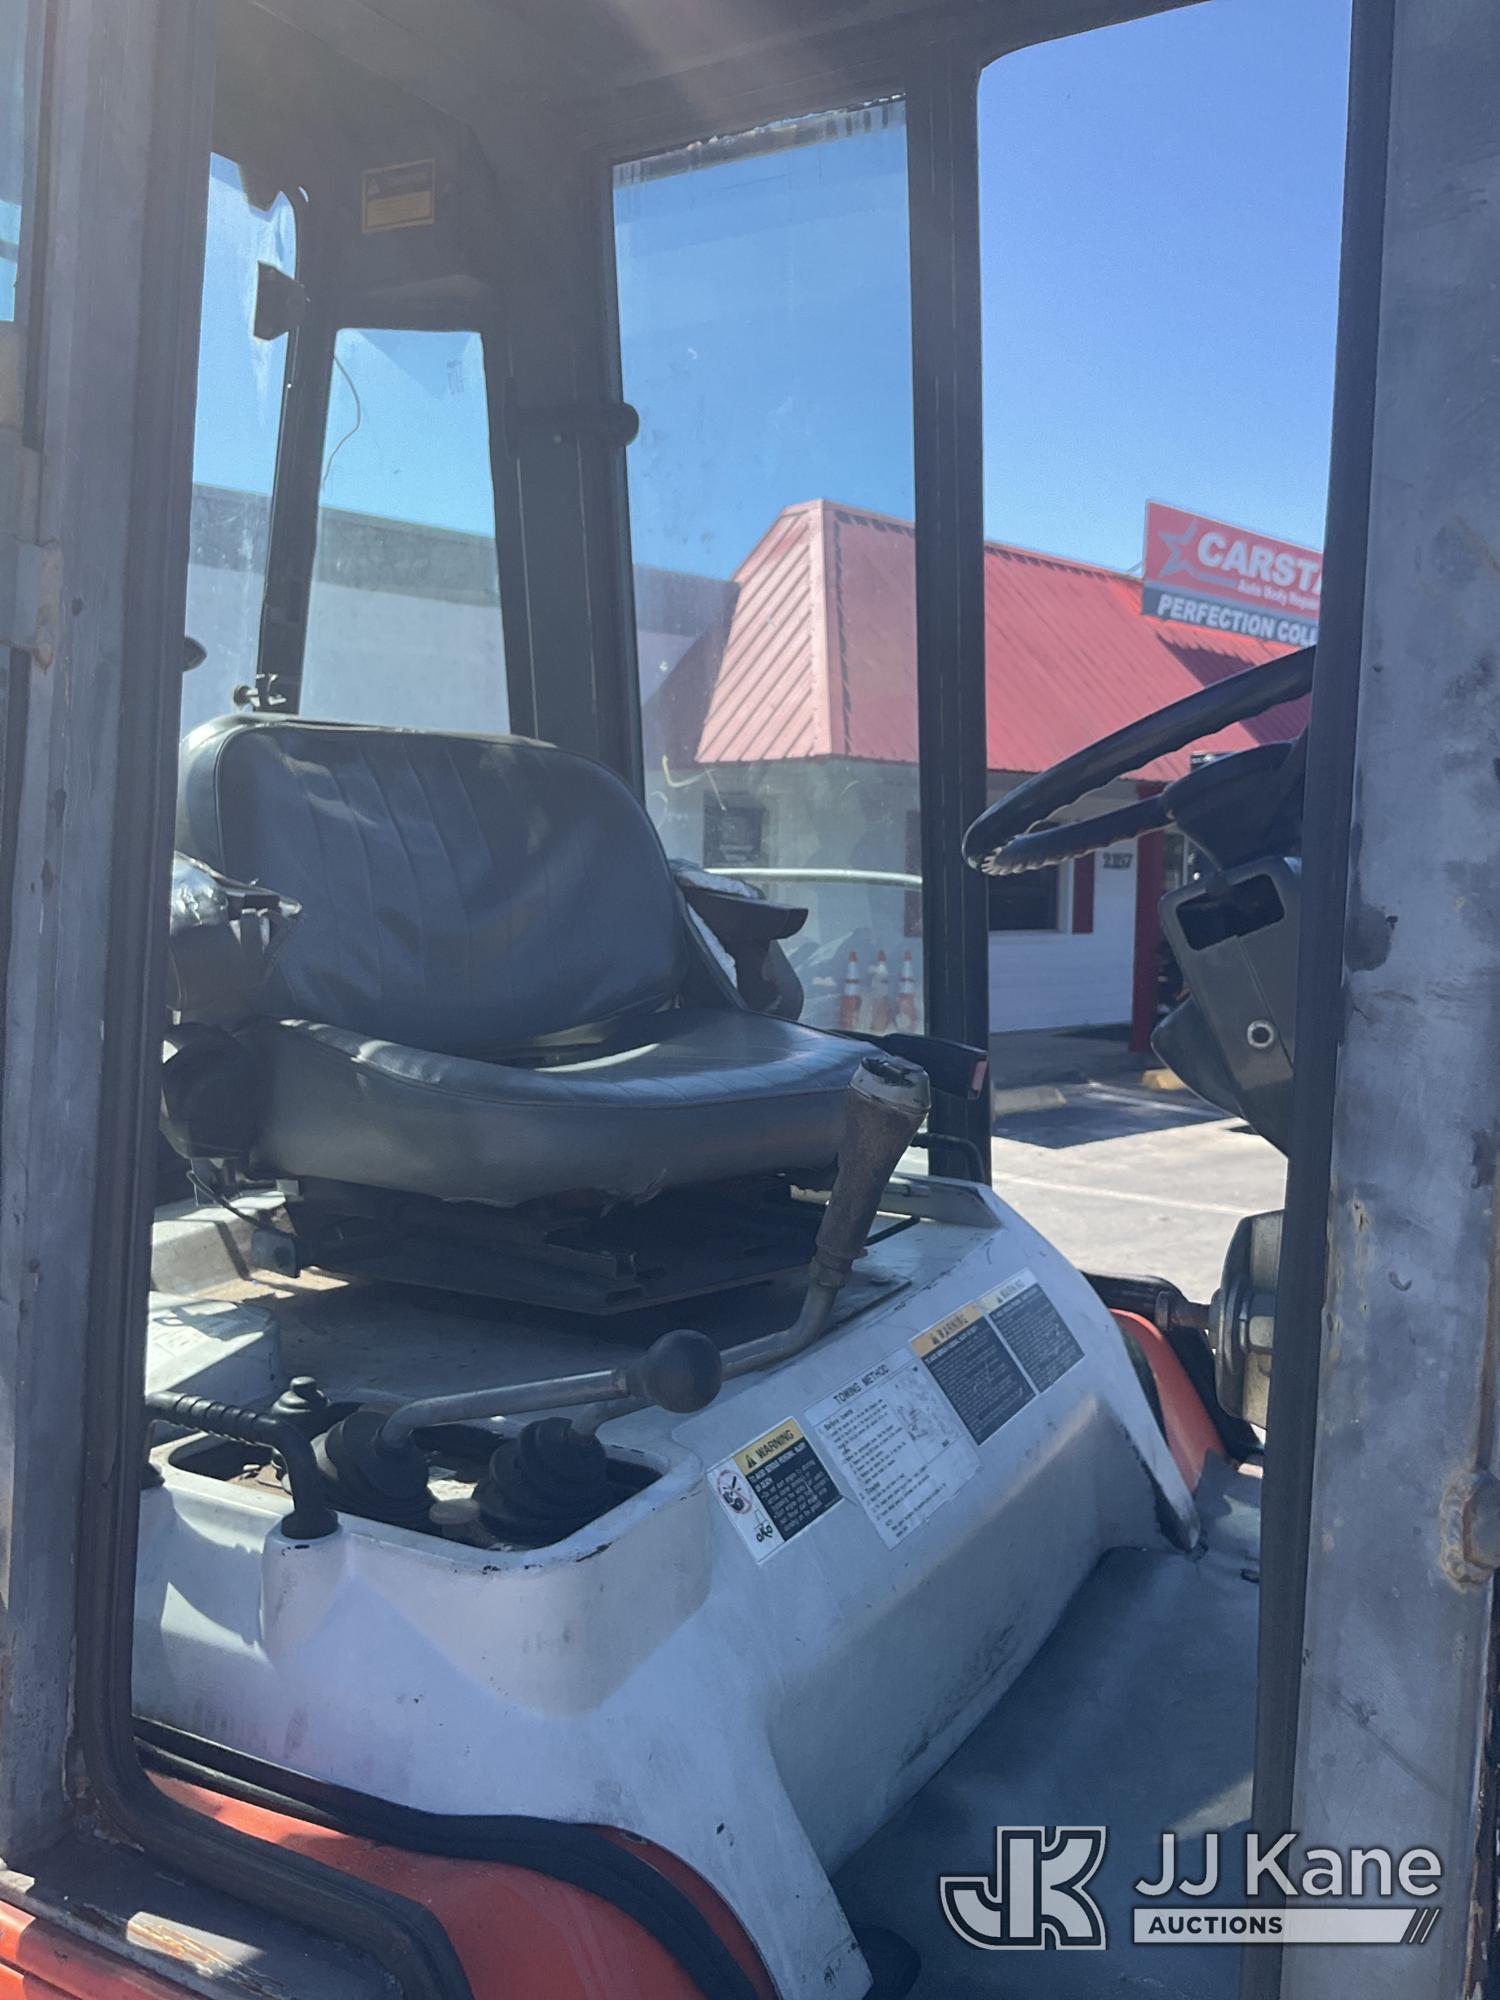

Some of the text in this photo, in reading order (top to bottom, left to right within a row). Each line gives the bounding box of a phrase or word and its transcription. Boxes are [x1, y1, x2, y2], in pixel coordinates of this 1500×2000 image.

[1197, 531, 1321, 595] CARST
[1157, 594, 1275, 639] PERFECTION
[833, 1364, 890, 1405] TOWING METHOD
[755, 1429, 794, 1459] WARNING
